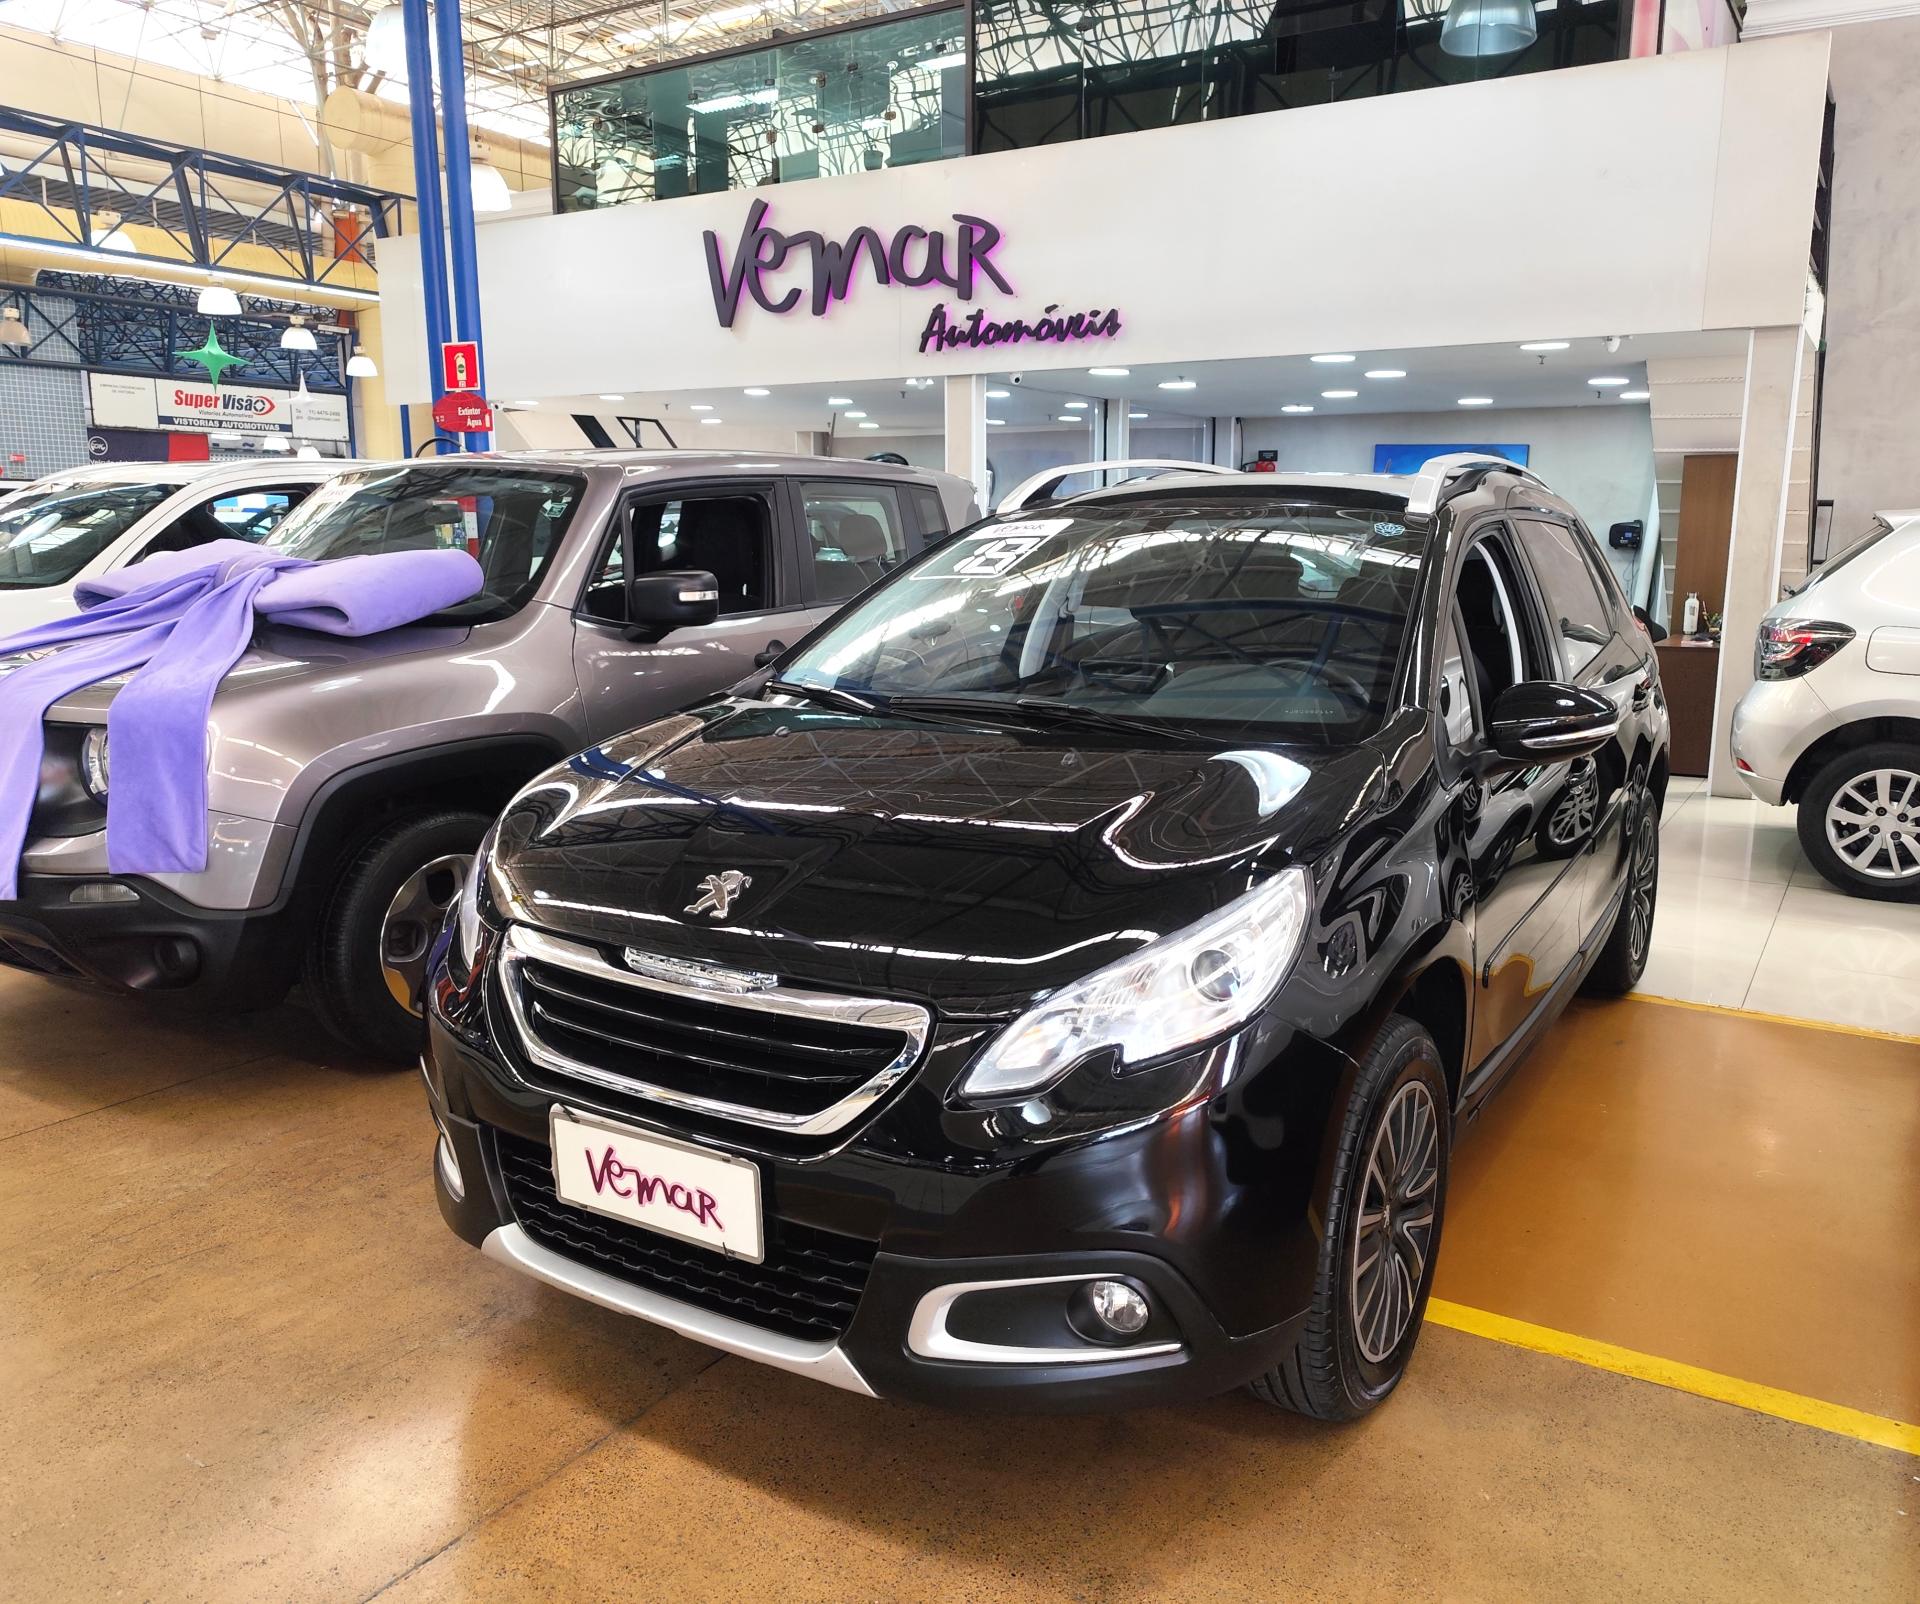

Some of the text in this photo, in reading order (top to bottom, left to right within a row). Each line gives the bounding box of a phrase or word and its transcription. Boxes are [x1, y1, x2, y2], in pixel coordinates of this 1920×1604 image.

[918, 303, 1122, 353] Automóveis
[174, 389, 266, 413] Super Visão
[198, 409, 254, 419] Vistorias Automotivas
[457, 406, 481, 416] Extintor
[173, 417, 280, 431] VISTORIAS AUTOMOTIVAS
[466, 416, 482, 429] Água
